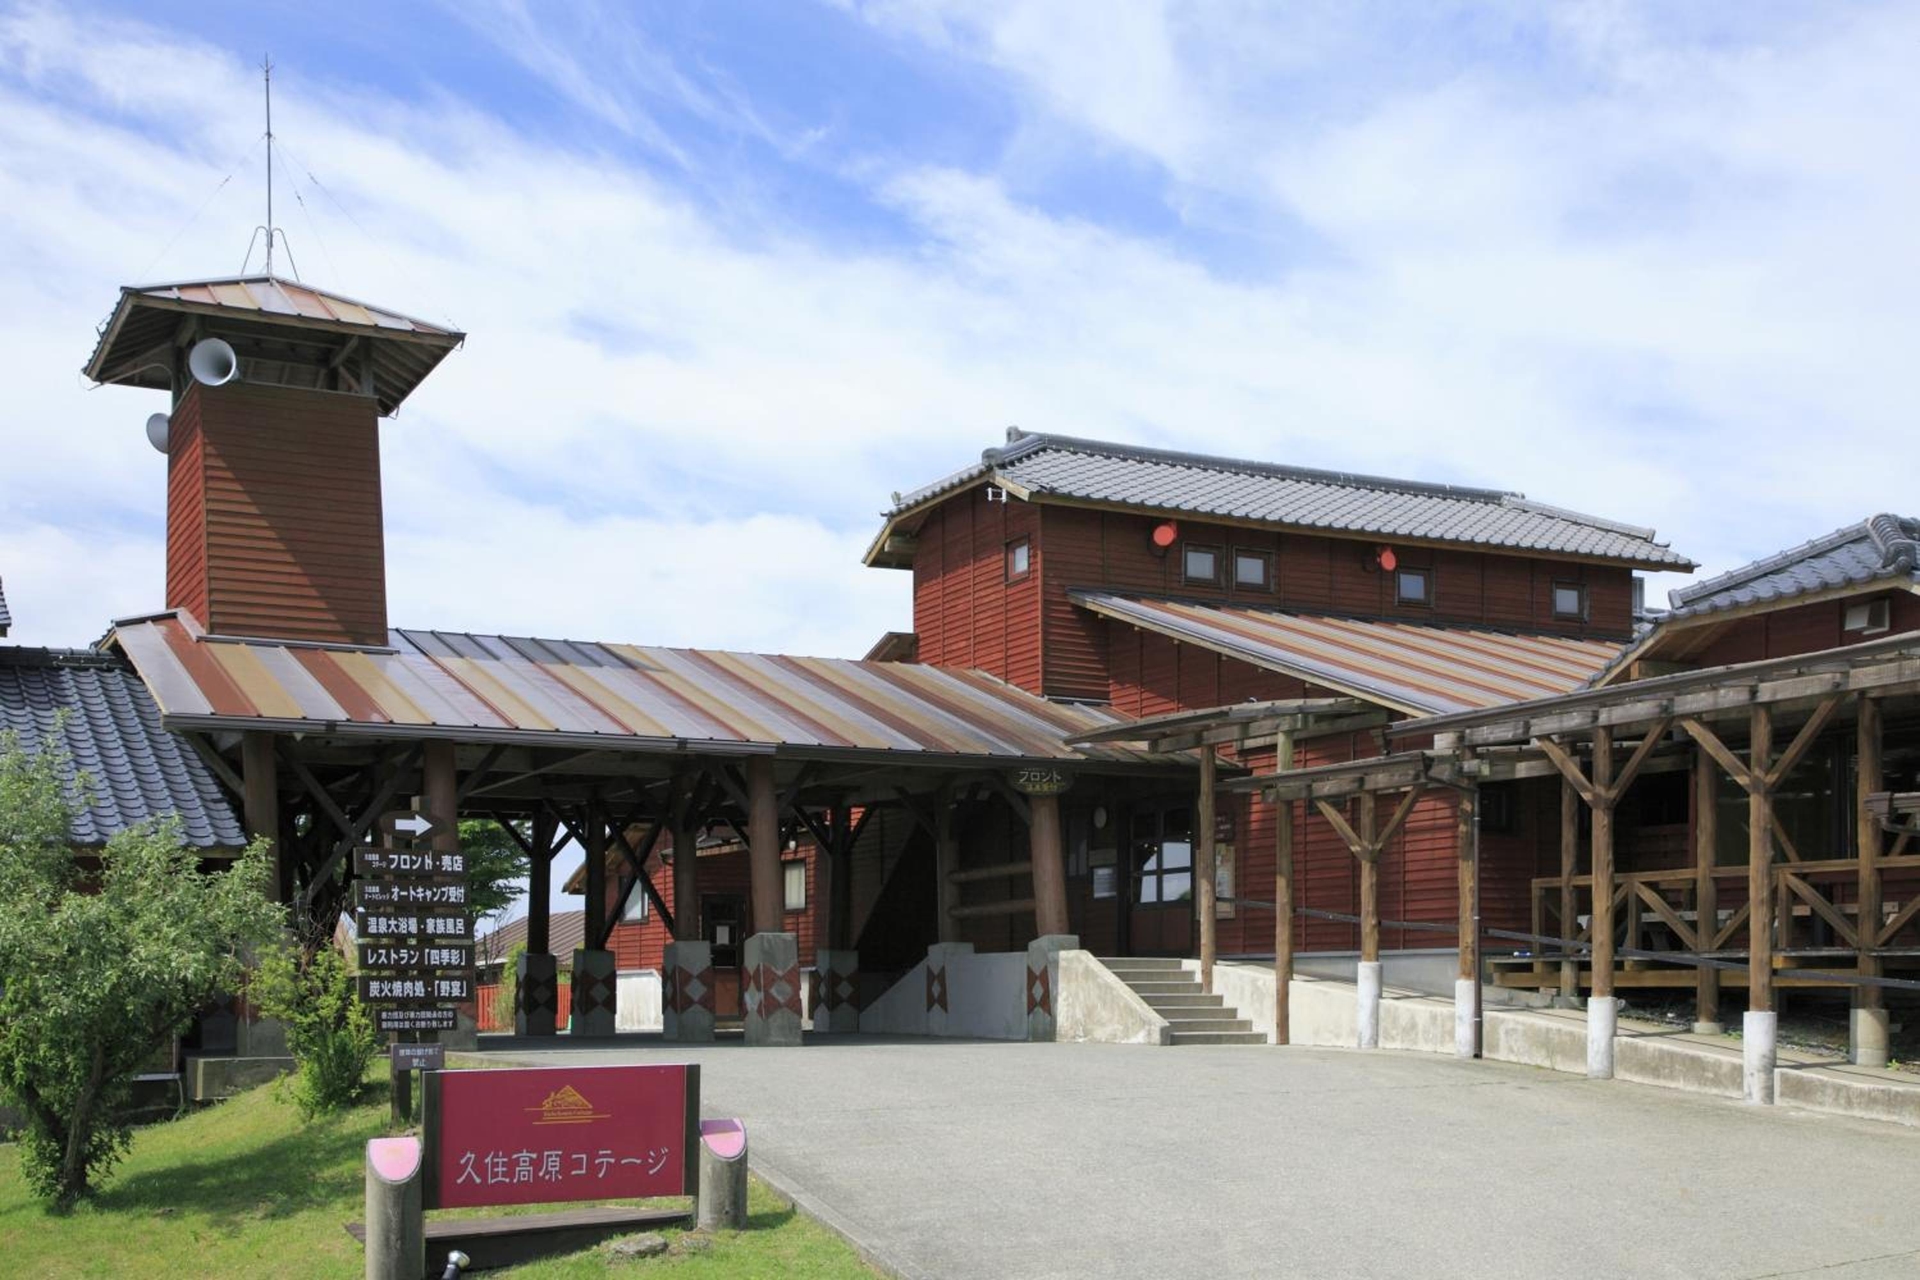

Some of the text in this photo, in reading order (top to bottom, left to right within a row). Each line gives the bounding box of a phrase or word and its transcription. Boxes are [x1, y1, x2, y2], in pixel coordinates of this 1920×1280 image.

[1018, 771, 1062, 783] フロント
[388, 852, 463, 872] フロント・売店
[391, 885, 465, 903] オートキャンプ受付
[367, 917, 465, 934] 温泉大浴場・家族風呂
[367, 948, 466, 966] レストラン「四季彩」
[369, 980, 467, 998] 炭火焼肉処・「野宴」
[456, 1147, 668, 1184] 久住高原コテージ
